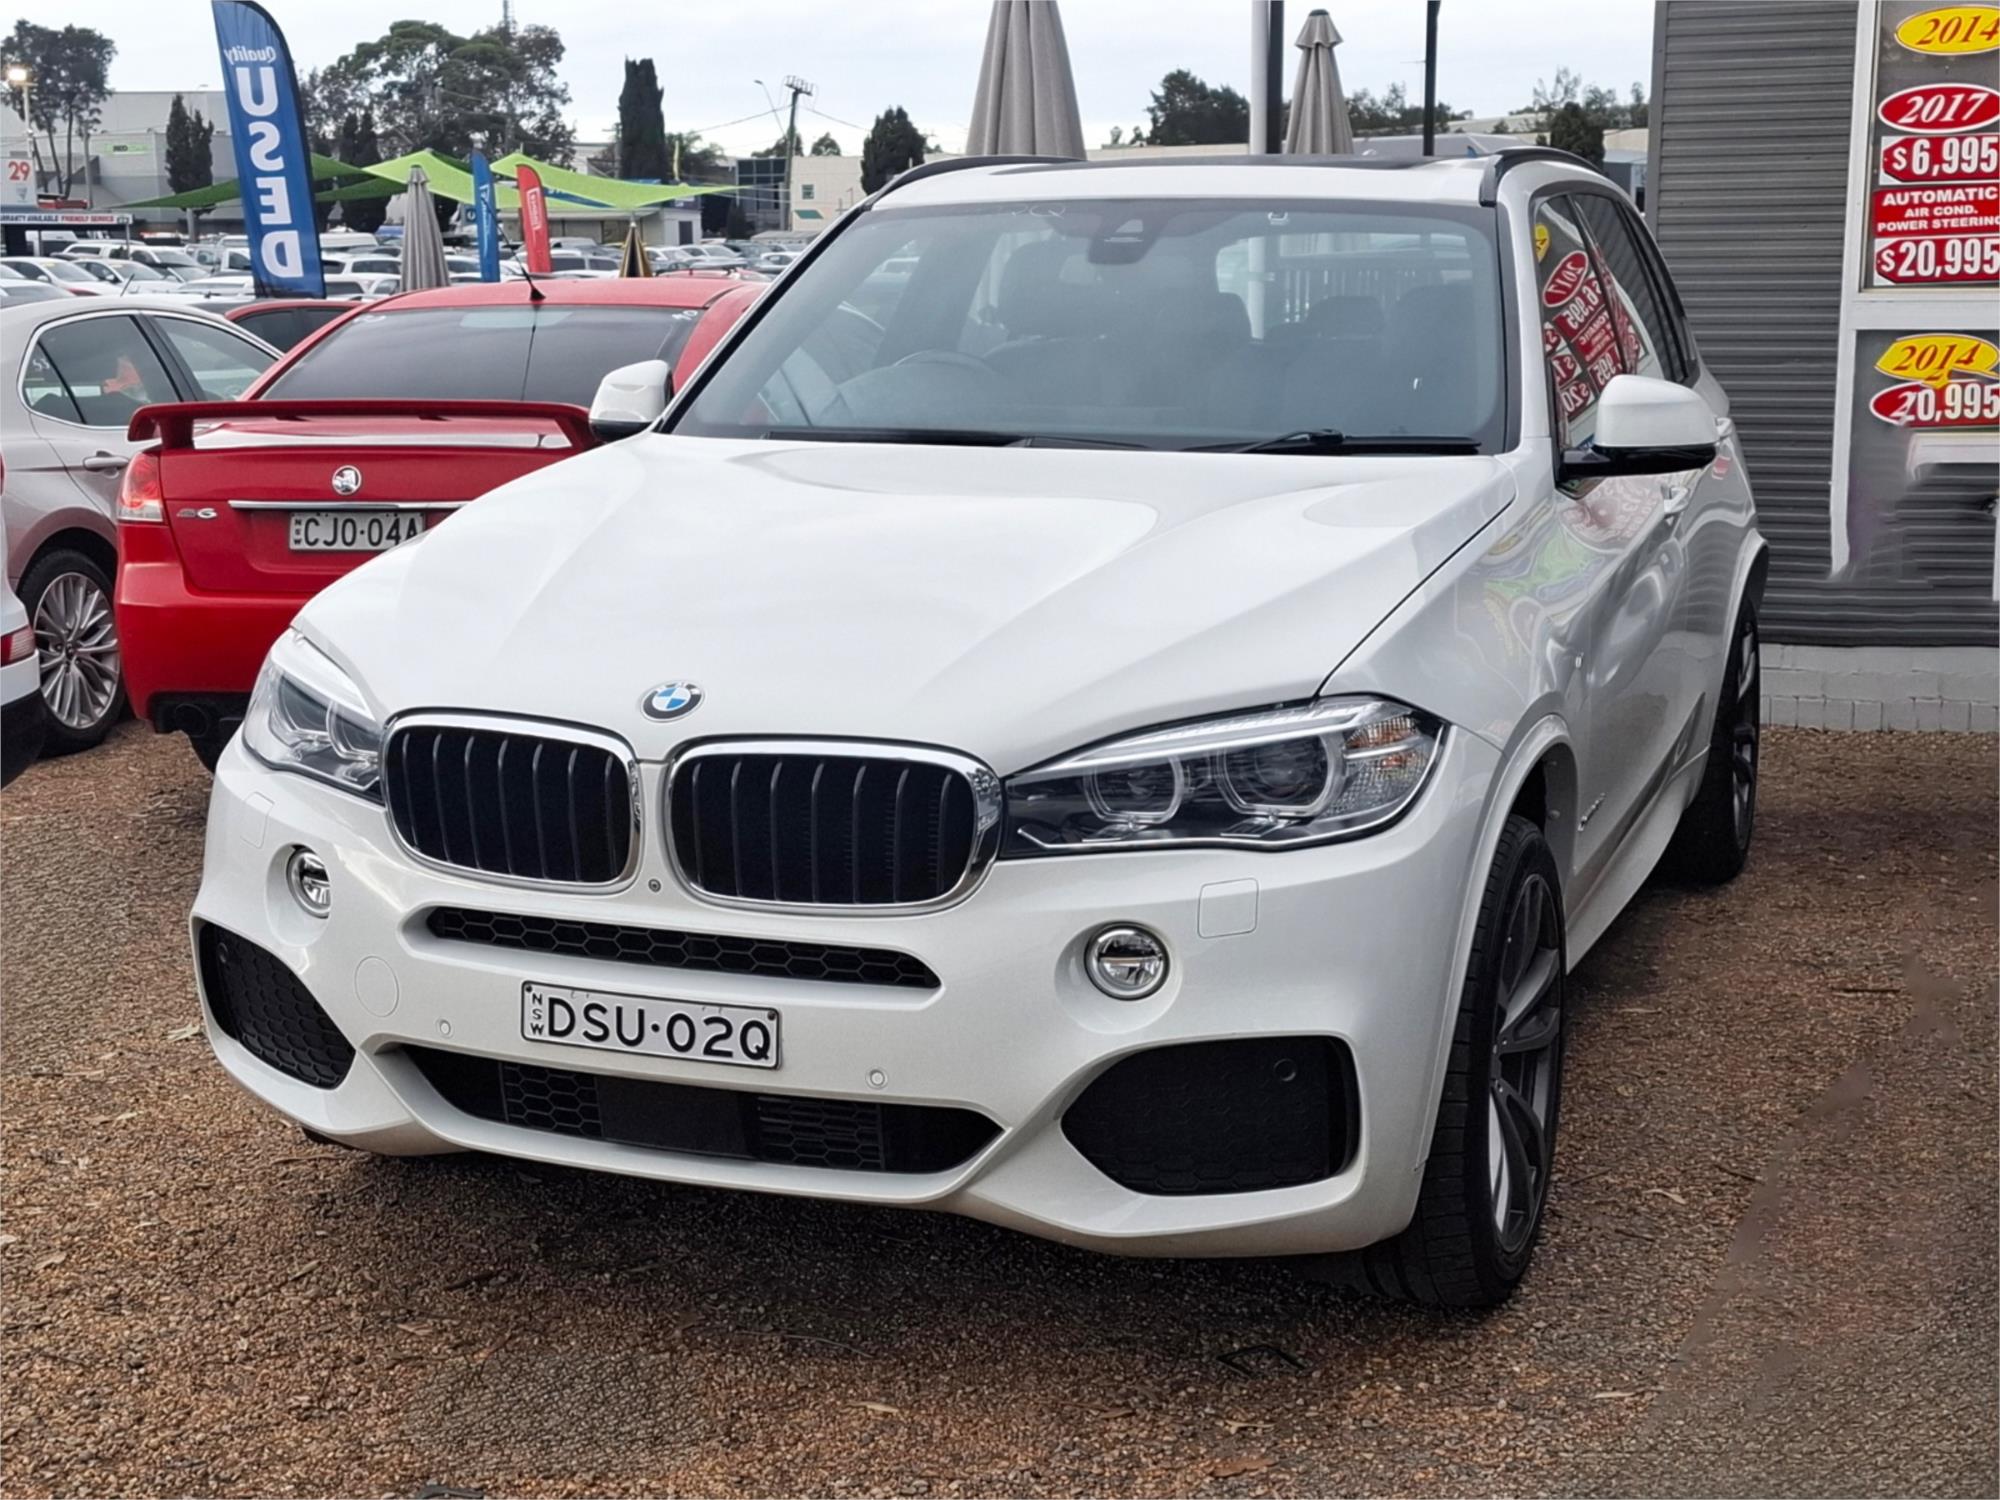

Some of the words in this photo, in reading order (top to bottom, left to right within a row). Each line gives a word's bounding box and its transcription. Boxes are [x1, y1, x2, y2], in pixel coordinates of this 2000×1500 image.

[1915, 15, 2000, 45] 2014
[1897, 92, 1989, 124] 2017
[8, 161, 30, 181] 29
[1892, 136, 1998, 177] $6,995
[1882, 186, 1998, 207] AUTOMATIC
[1904, 207, 1930, 218] AIR
[1933, 204, 1979, 217] COND.
[1877, 220, 1928, 232] POWER
[1880, 237, 2000, 278] $20,995
[1892, 343, 1981, 371] 2014
[530, 992, 544, 1036] NSW
